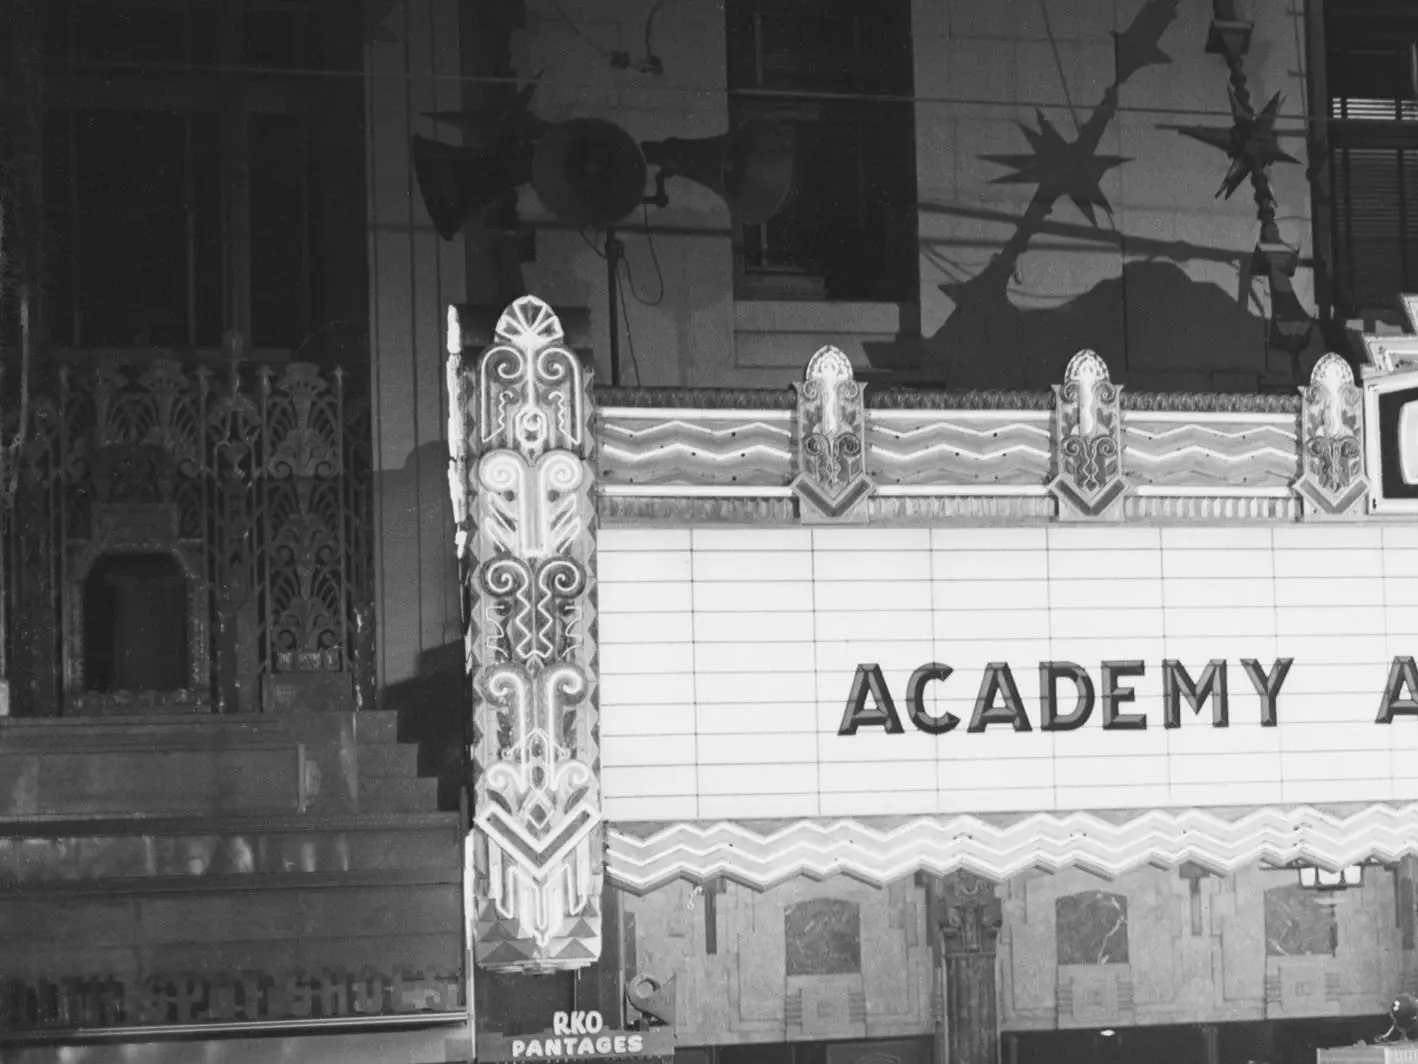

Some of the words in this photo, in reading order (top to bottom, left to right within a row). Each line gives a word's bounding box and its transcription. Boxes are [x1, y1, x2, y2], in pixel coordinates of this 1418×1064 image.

[838, 659, 1294, 736] ACADEMY
[553, 1010, 603, 1036] RKO
[511, 1035, 644, 1058] PANTAGES
